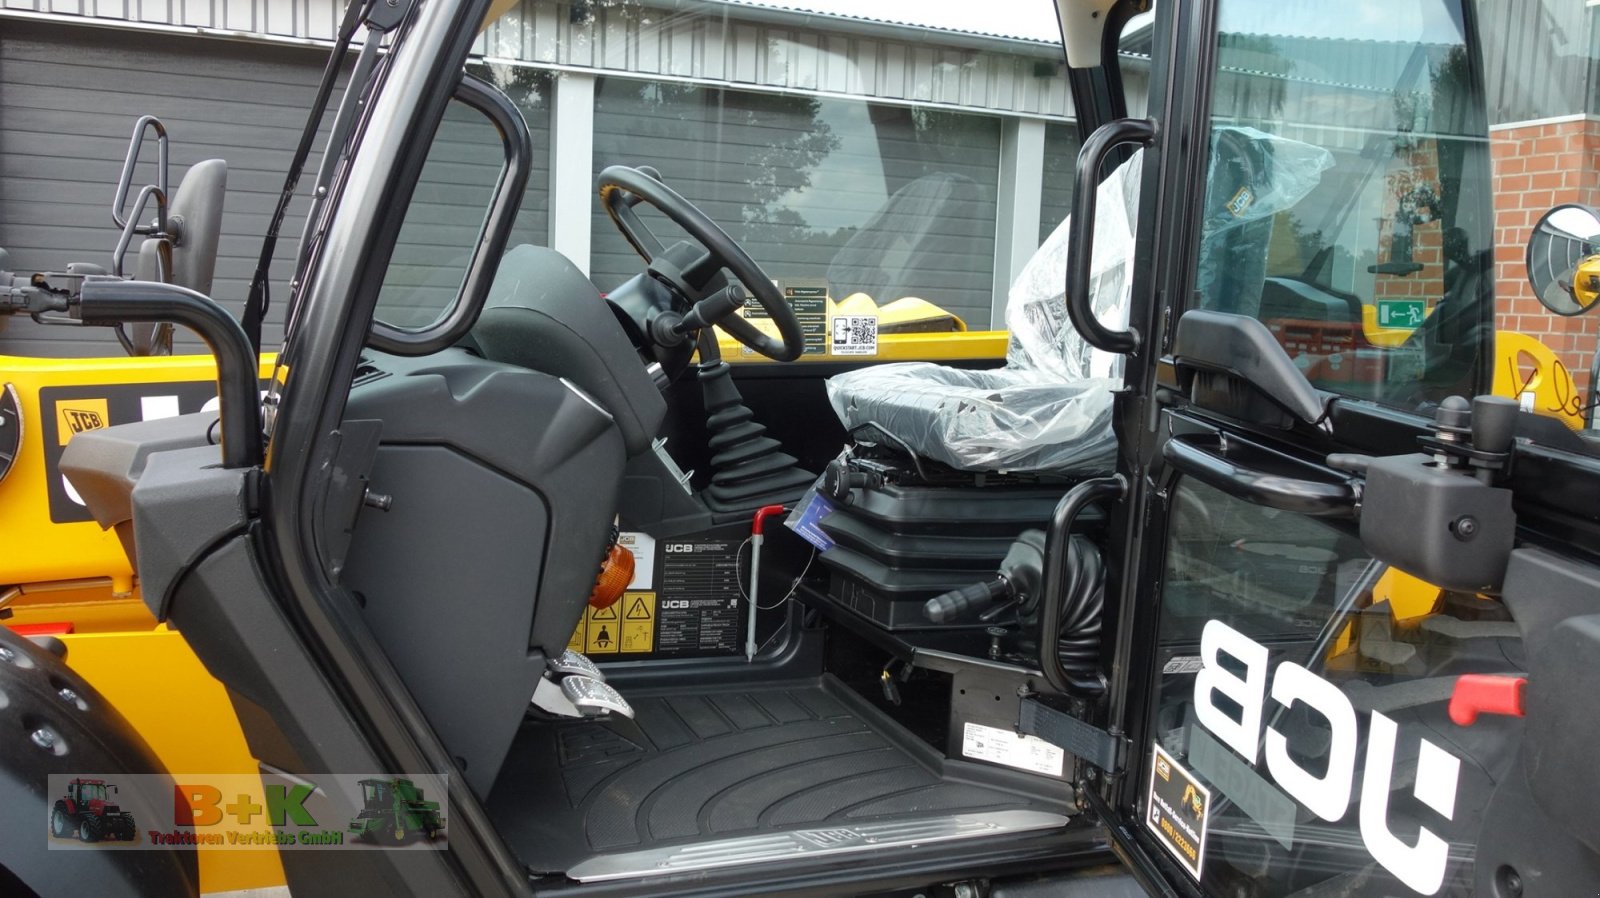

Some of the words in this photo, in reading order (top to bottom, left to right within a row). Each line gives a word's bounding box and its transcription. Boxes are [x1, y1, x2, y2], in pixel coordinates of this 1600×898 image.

[1234, 191, 1249, 212] JCB
[71, 412, 100, 433] JCB
[665, 544, 693, 553] JCB
[662, 599, 690, 609] JCB
